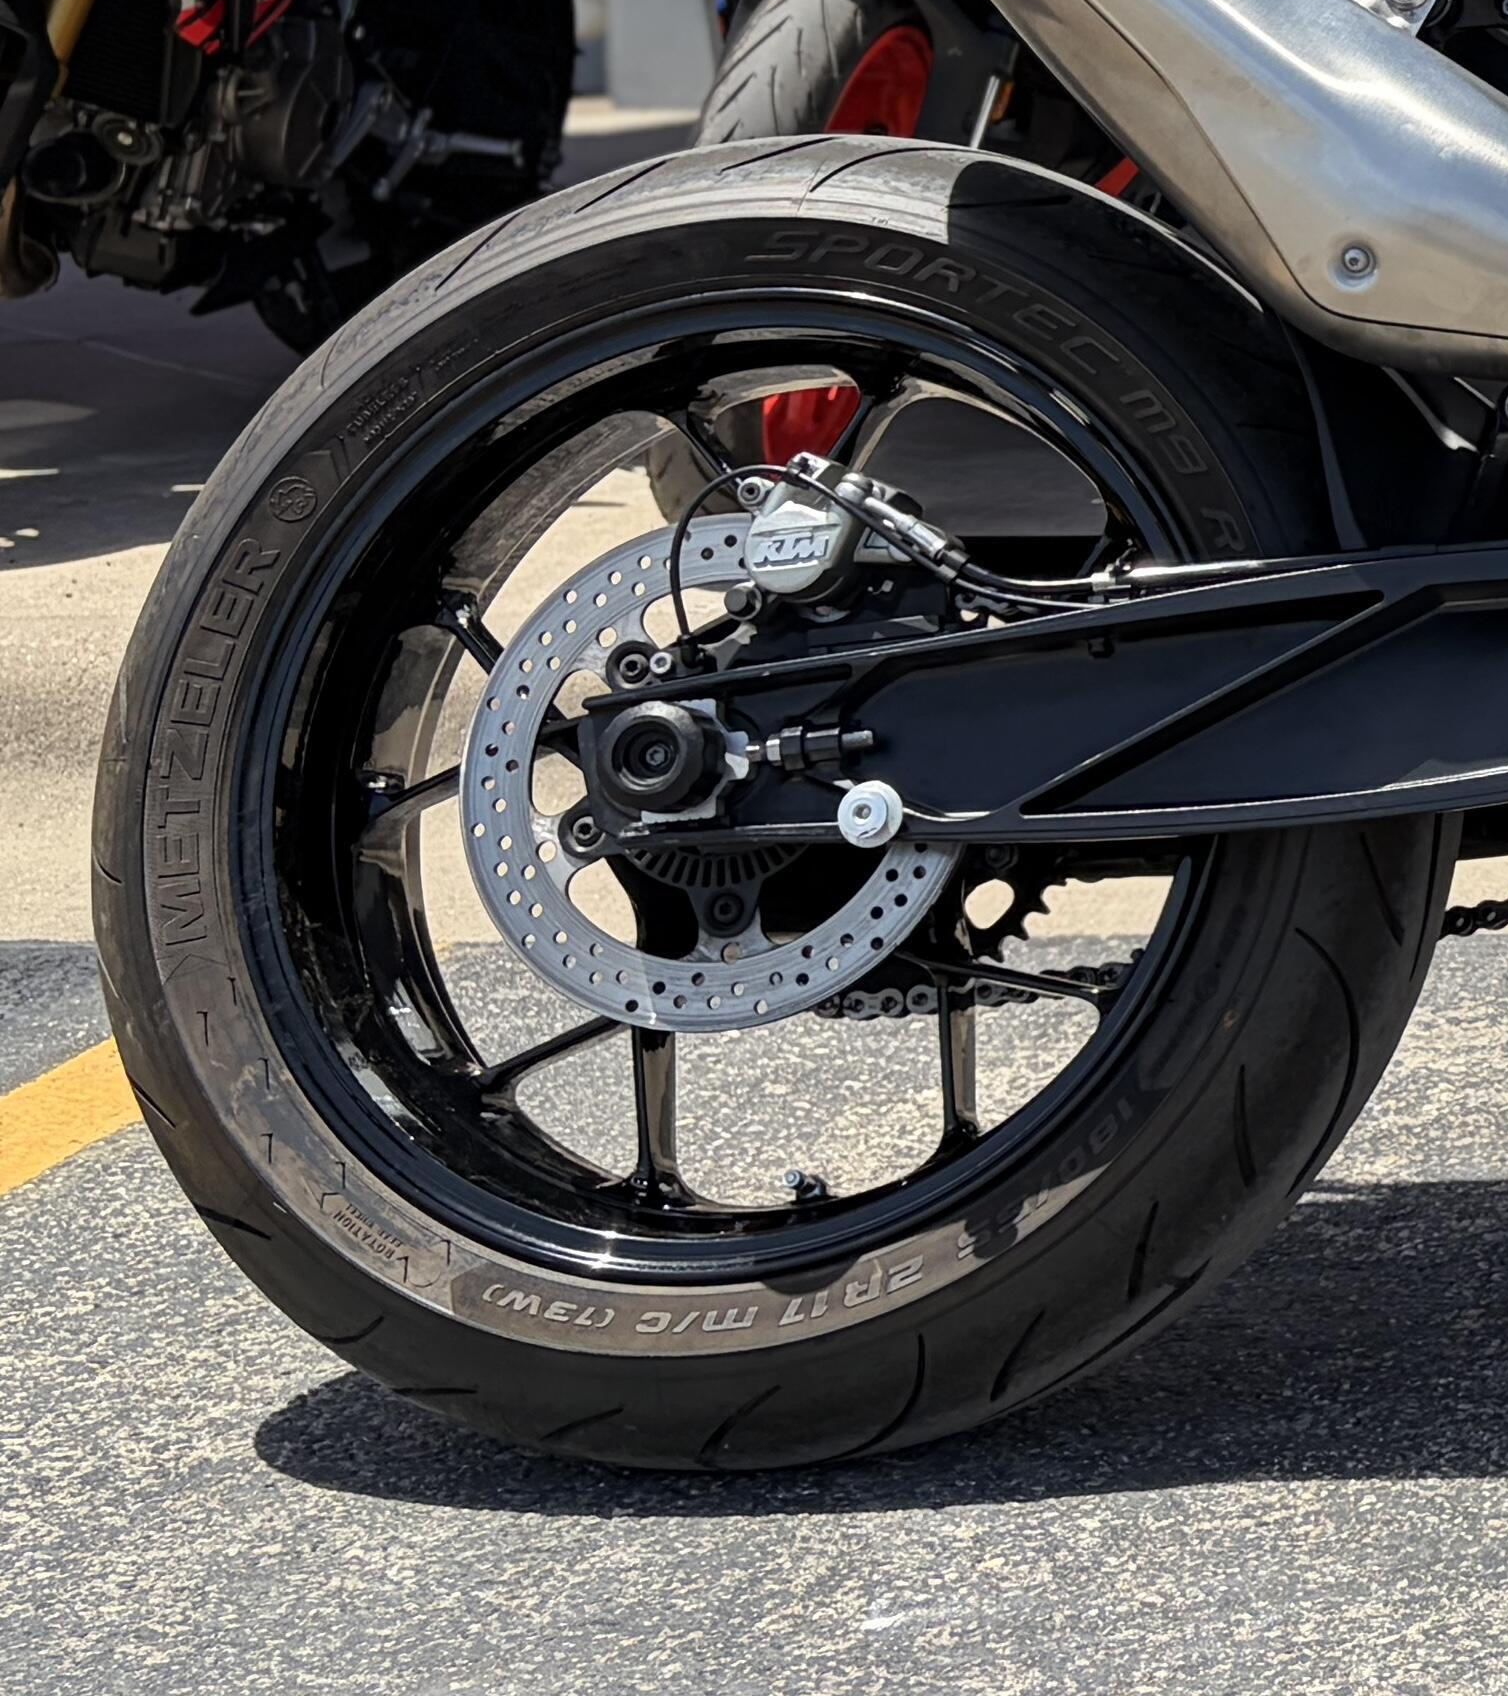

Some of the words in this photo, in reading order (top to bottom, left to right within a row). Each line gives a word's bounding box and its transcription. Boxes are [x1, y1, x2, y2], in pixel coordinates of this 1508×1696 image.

[743, 230, 1122, 375] SPORTEC
[1119, 389, 1208, 475] M9
[753, 531, 829, 567] KTM
[157, 537, 281, 947] METZELER
[332, 1209, 397, 1260] ROTATION
[481, 1283, 615, 1328] (73W)
[779, 1297, 831, 1327] 17
